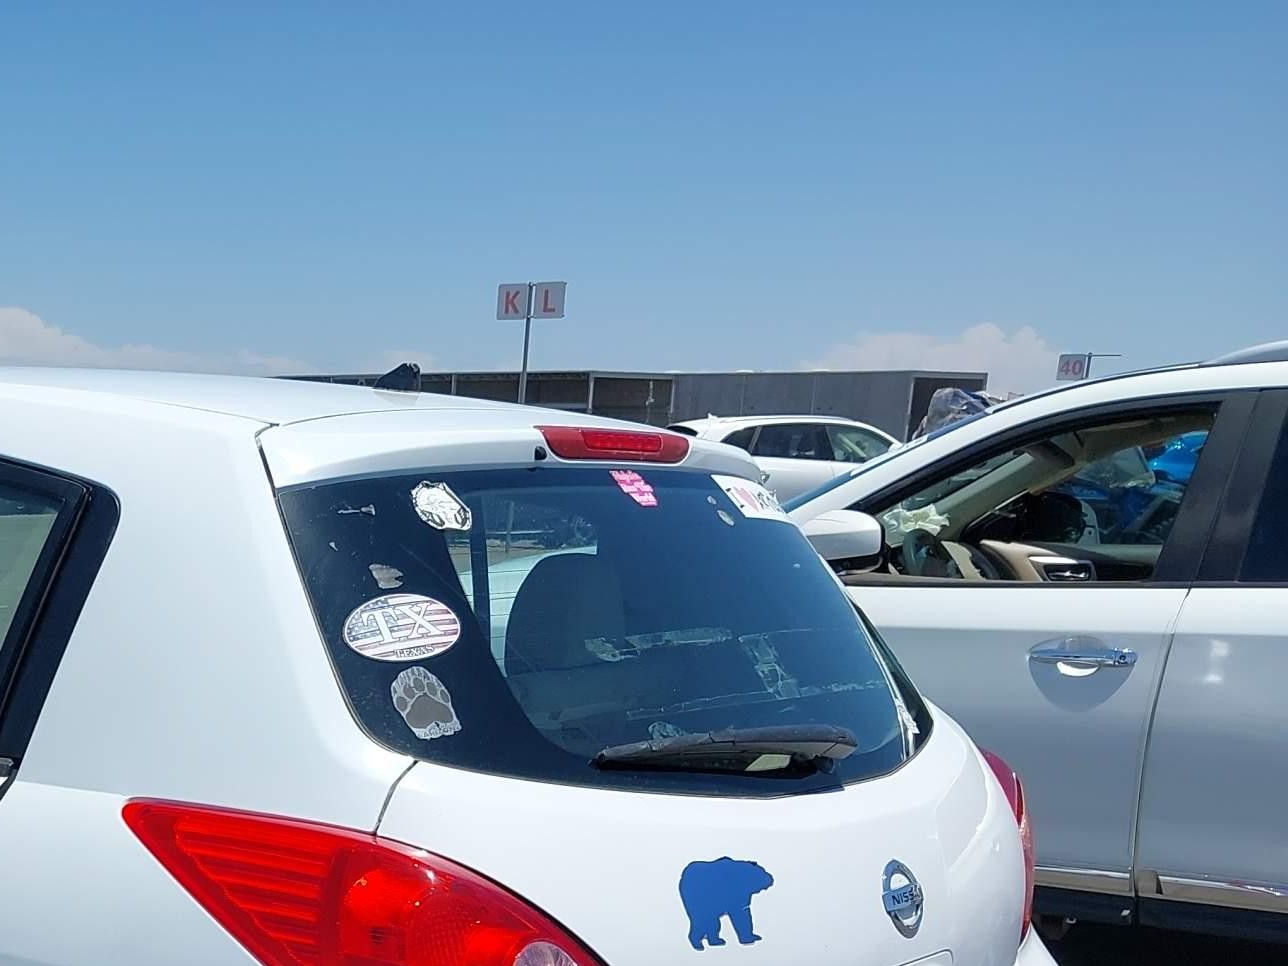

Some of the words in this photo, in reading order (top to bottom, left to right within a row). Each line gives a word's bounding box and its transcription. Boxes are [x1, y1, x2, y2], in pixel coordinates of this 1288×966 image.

[503, 290, 521, 314] K
[542, 288, 556, 313] L
[1060, 359, 1083, 376] 40
[360, 602, 444, 644] TX
[394, 644, 436, 659] TEXAS
